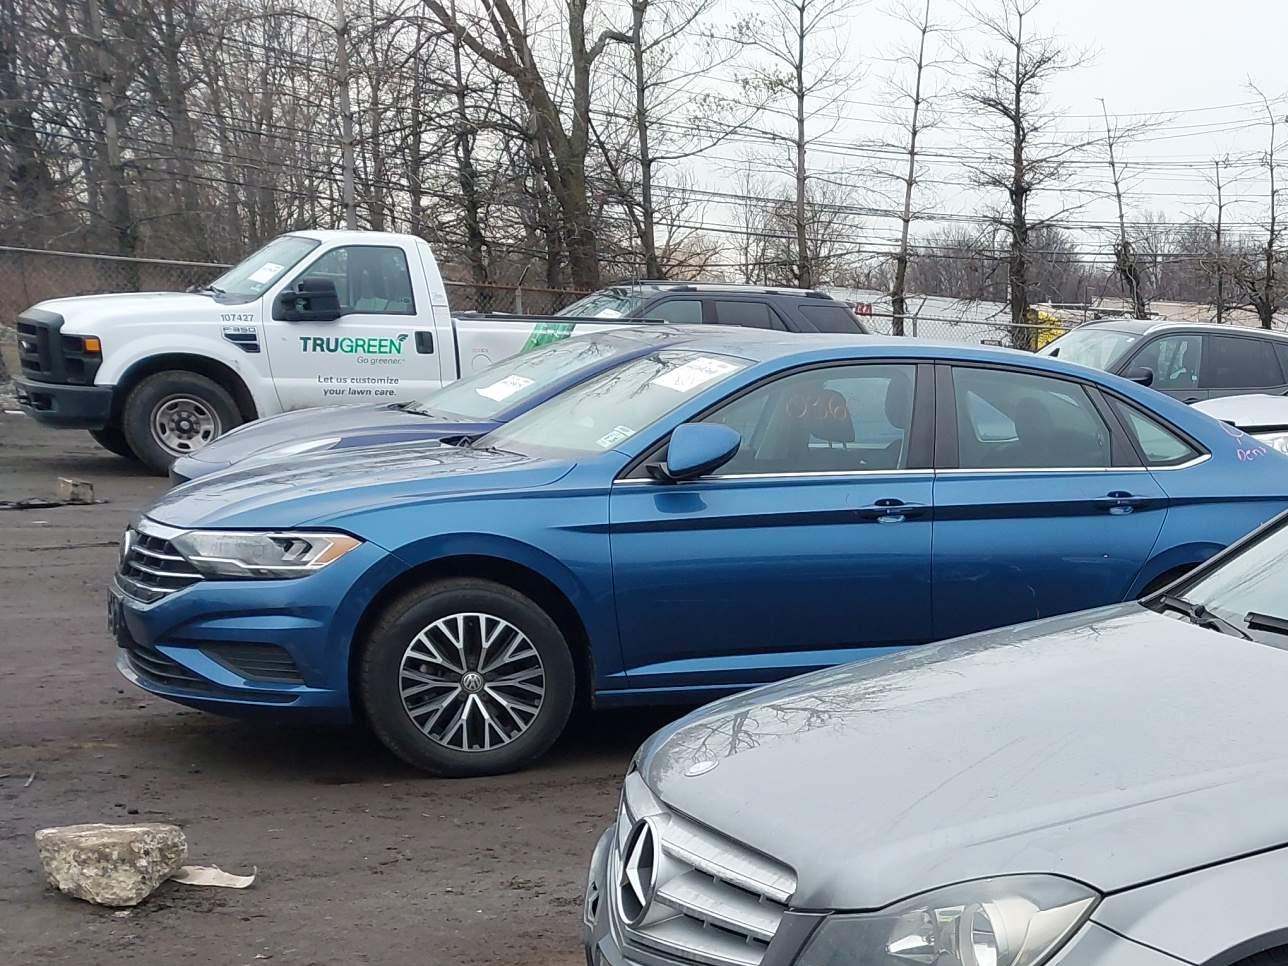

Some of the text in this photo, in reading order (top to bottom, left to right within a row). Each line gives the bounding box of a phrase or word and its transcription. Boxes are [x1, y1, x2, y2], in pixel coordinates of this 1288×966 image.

[220, 314, 254, 322] 107427
[300, 337, 401, 354] TRUGREEN
[357, 356, 369, 364] Go
[318, 374, 399, 385] Let us customize
[324, 386, 397, 396] your lawn care.
